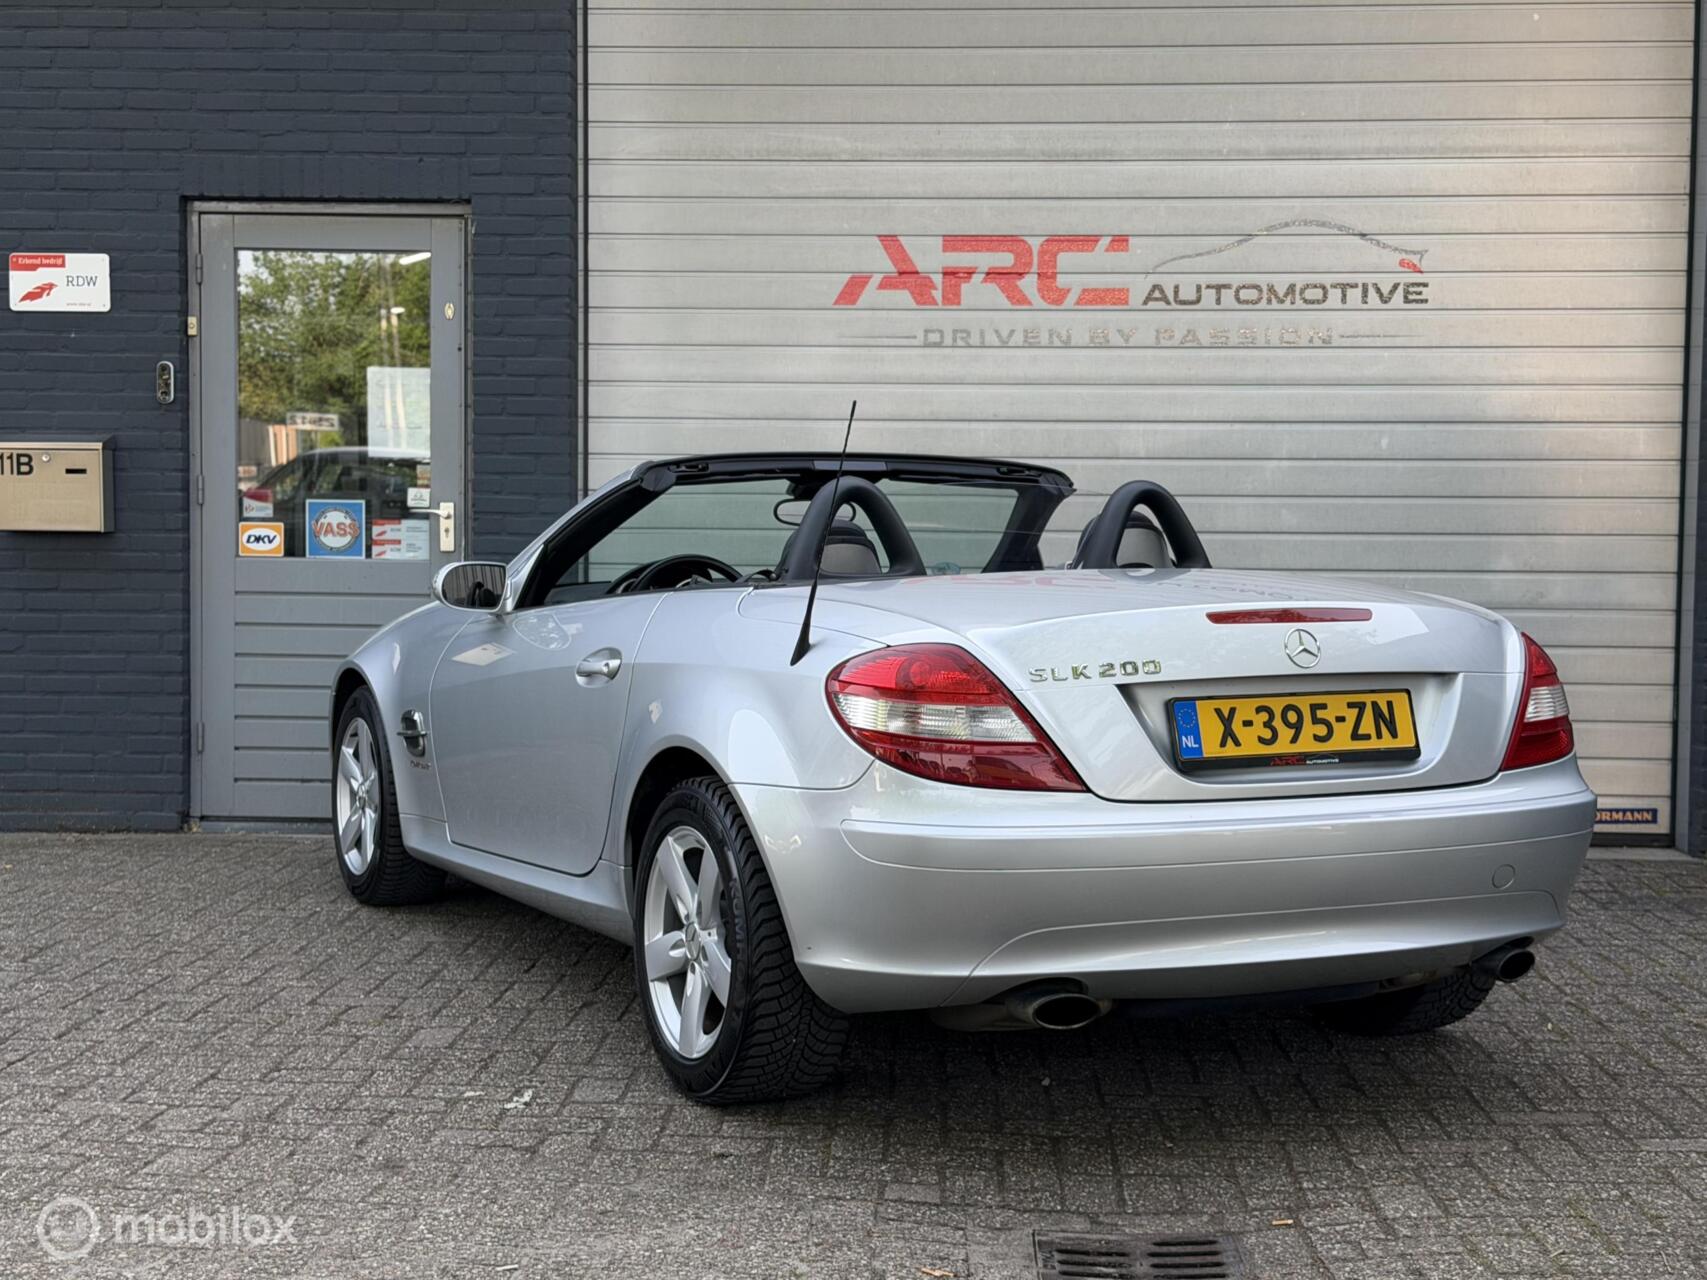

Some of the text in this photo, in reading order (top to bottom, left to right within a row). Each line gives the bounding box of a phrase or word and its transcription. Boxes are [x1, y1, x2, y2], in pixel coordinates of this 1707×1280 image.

[833, 235, 1429, 306] ARC AUTOMOTIVE
[66, 275, 98, 287] RDW
[923, 327, 1333, 346] DRIVEN BY PASSION
[0, 452, 34, 475] 11B
[245, 534, 277, 544] DKV
[312, 521, 359, 538] VASS
[1028, 659, 1163, 683] SLK 200
[1214, 700, 1399, 748] X-395-ZN
[1181, 735, 1199, 749] NL
